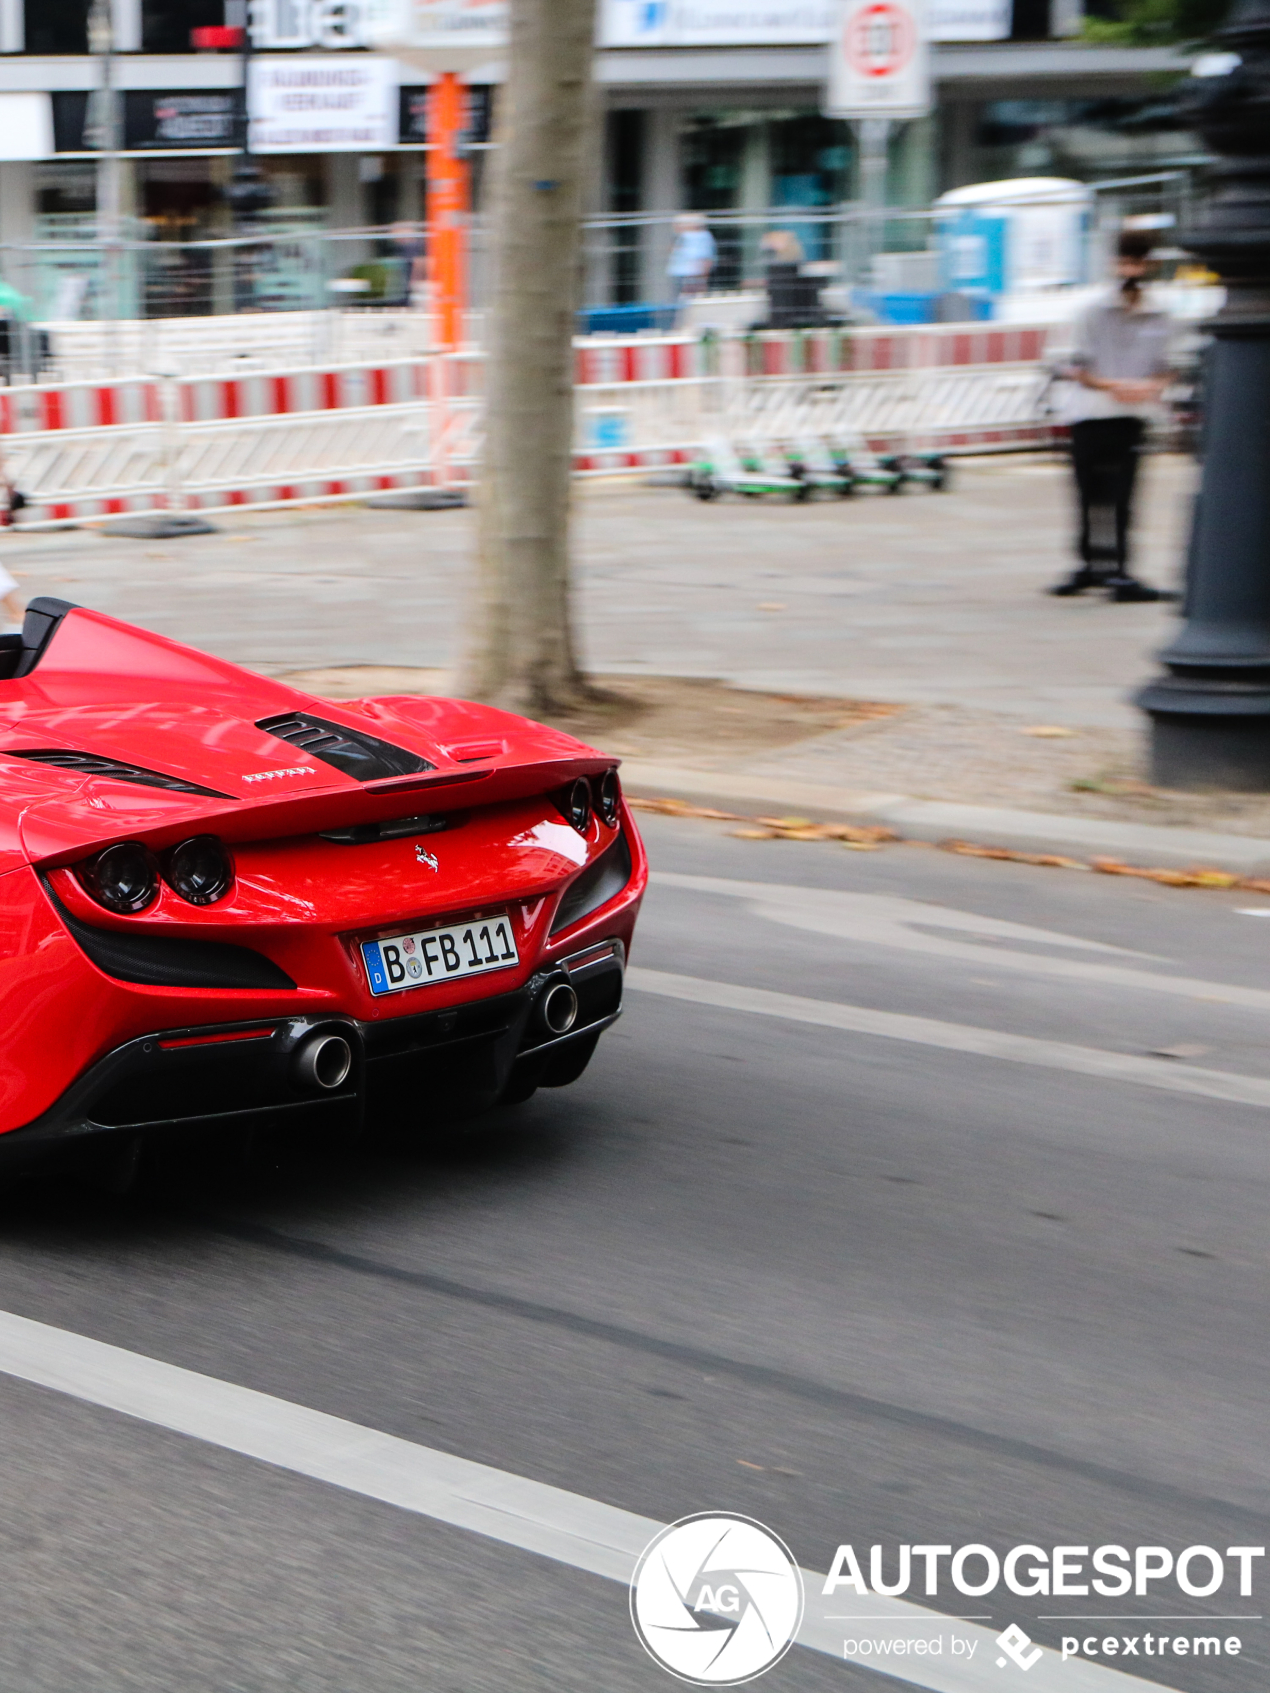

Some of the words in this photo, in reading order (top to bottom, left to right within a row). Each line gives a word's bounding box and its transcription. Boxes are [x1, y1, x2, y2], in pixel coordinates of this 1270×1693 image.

[374, 972, 382, 984] D
[382, 945, 405, 984] B
[420, 933, 461, 976] FB
[462, 922, 516, 967] 111
